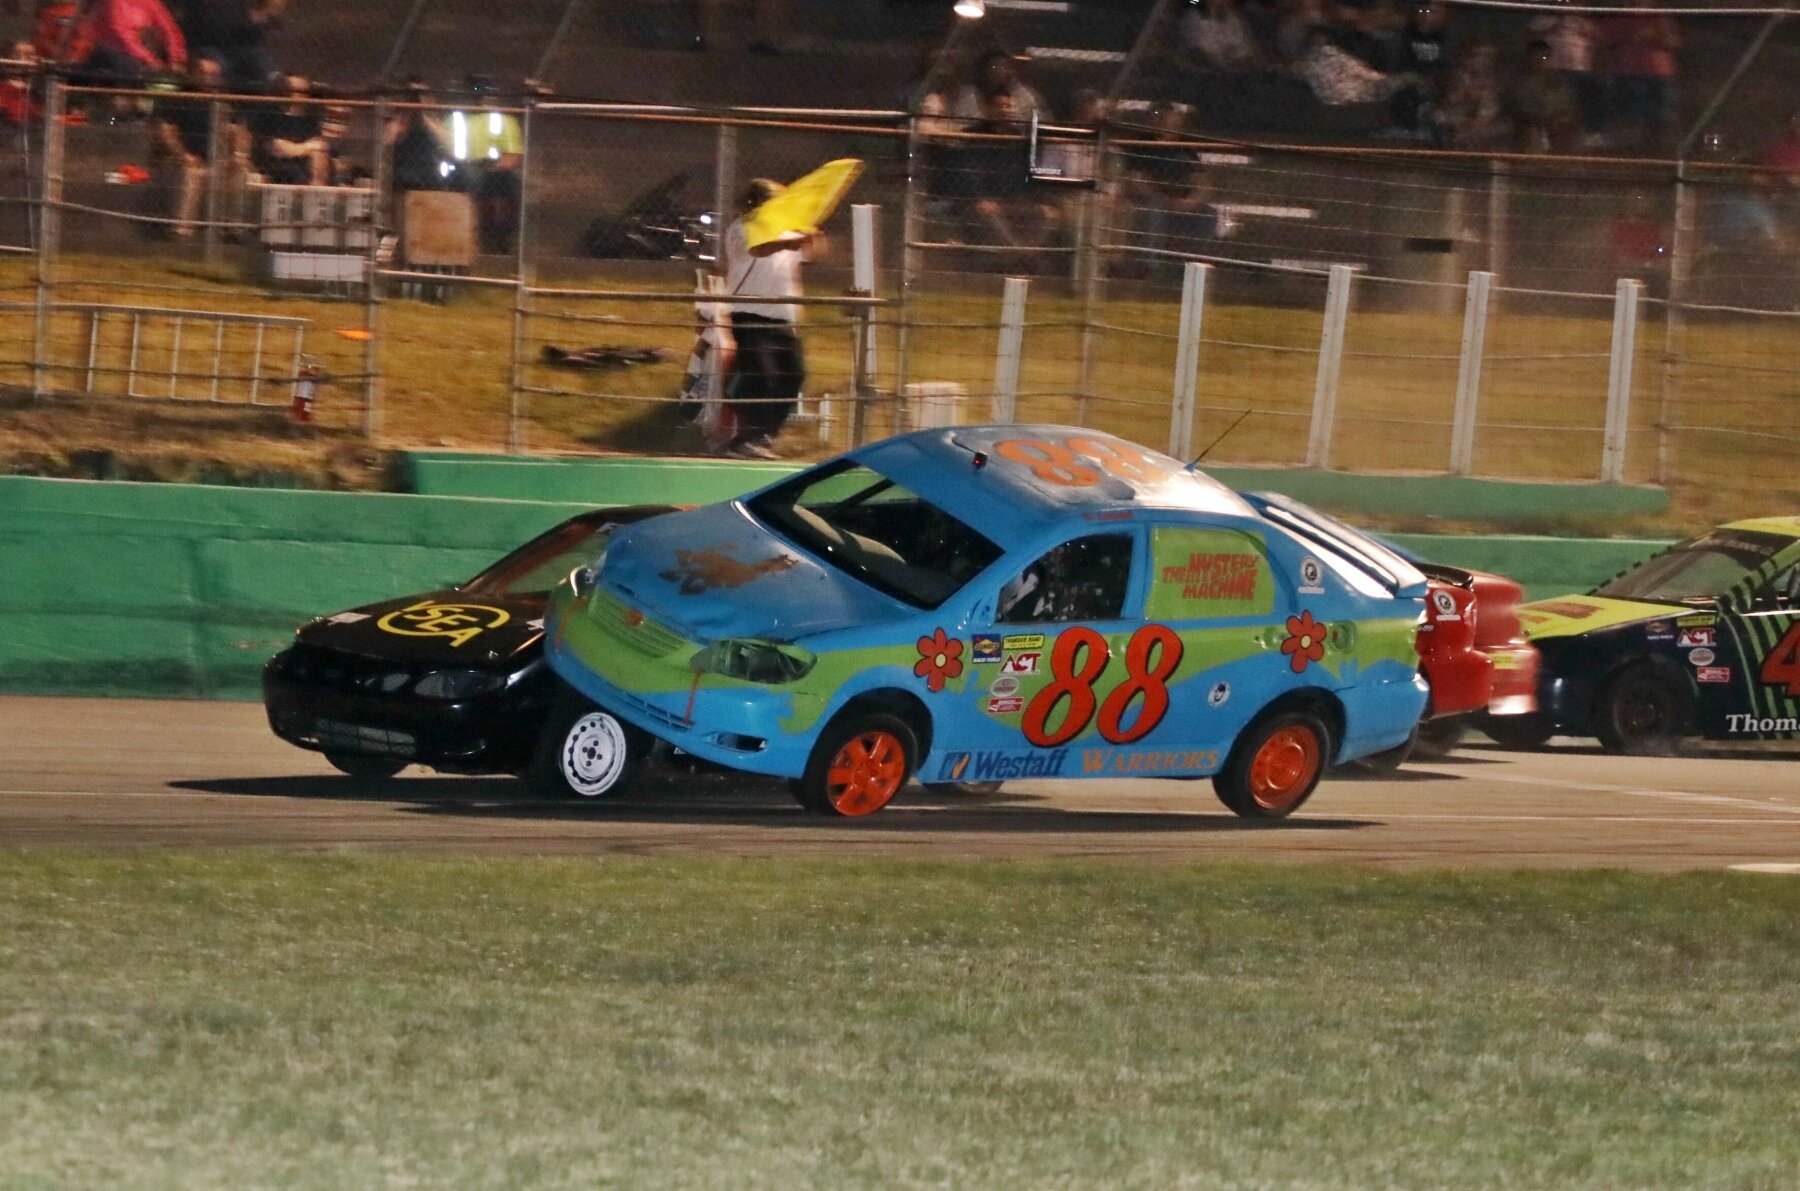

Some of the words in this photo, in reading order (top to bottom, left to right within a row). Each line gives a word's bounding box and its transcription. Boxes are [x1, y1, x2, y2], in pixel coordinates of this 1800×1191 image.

[995, 437, 1170, 487] 88
[1183, 568, 1259, 600] MACHINE
[1188, 554, 1260, 584] MYSTERY
[1000, 653, 1042, 673] ACT
[1022, 625, 1183, 747] 88
[974, 749, 1070, 779] Westaff
[1082, 748, 1219, 774] WARRIORS
